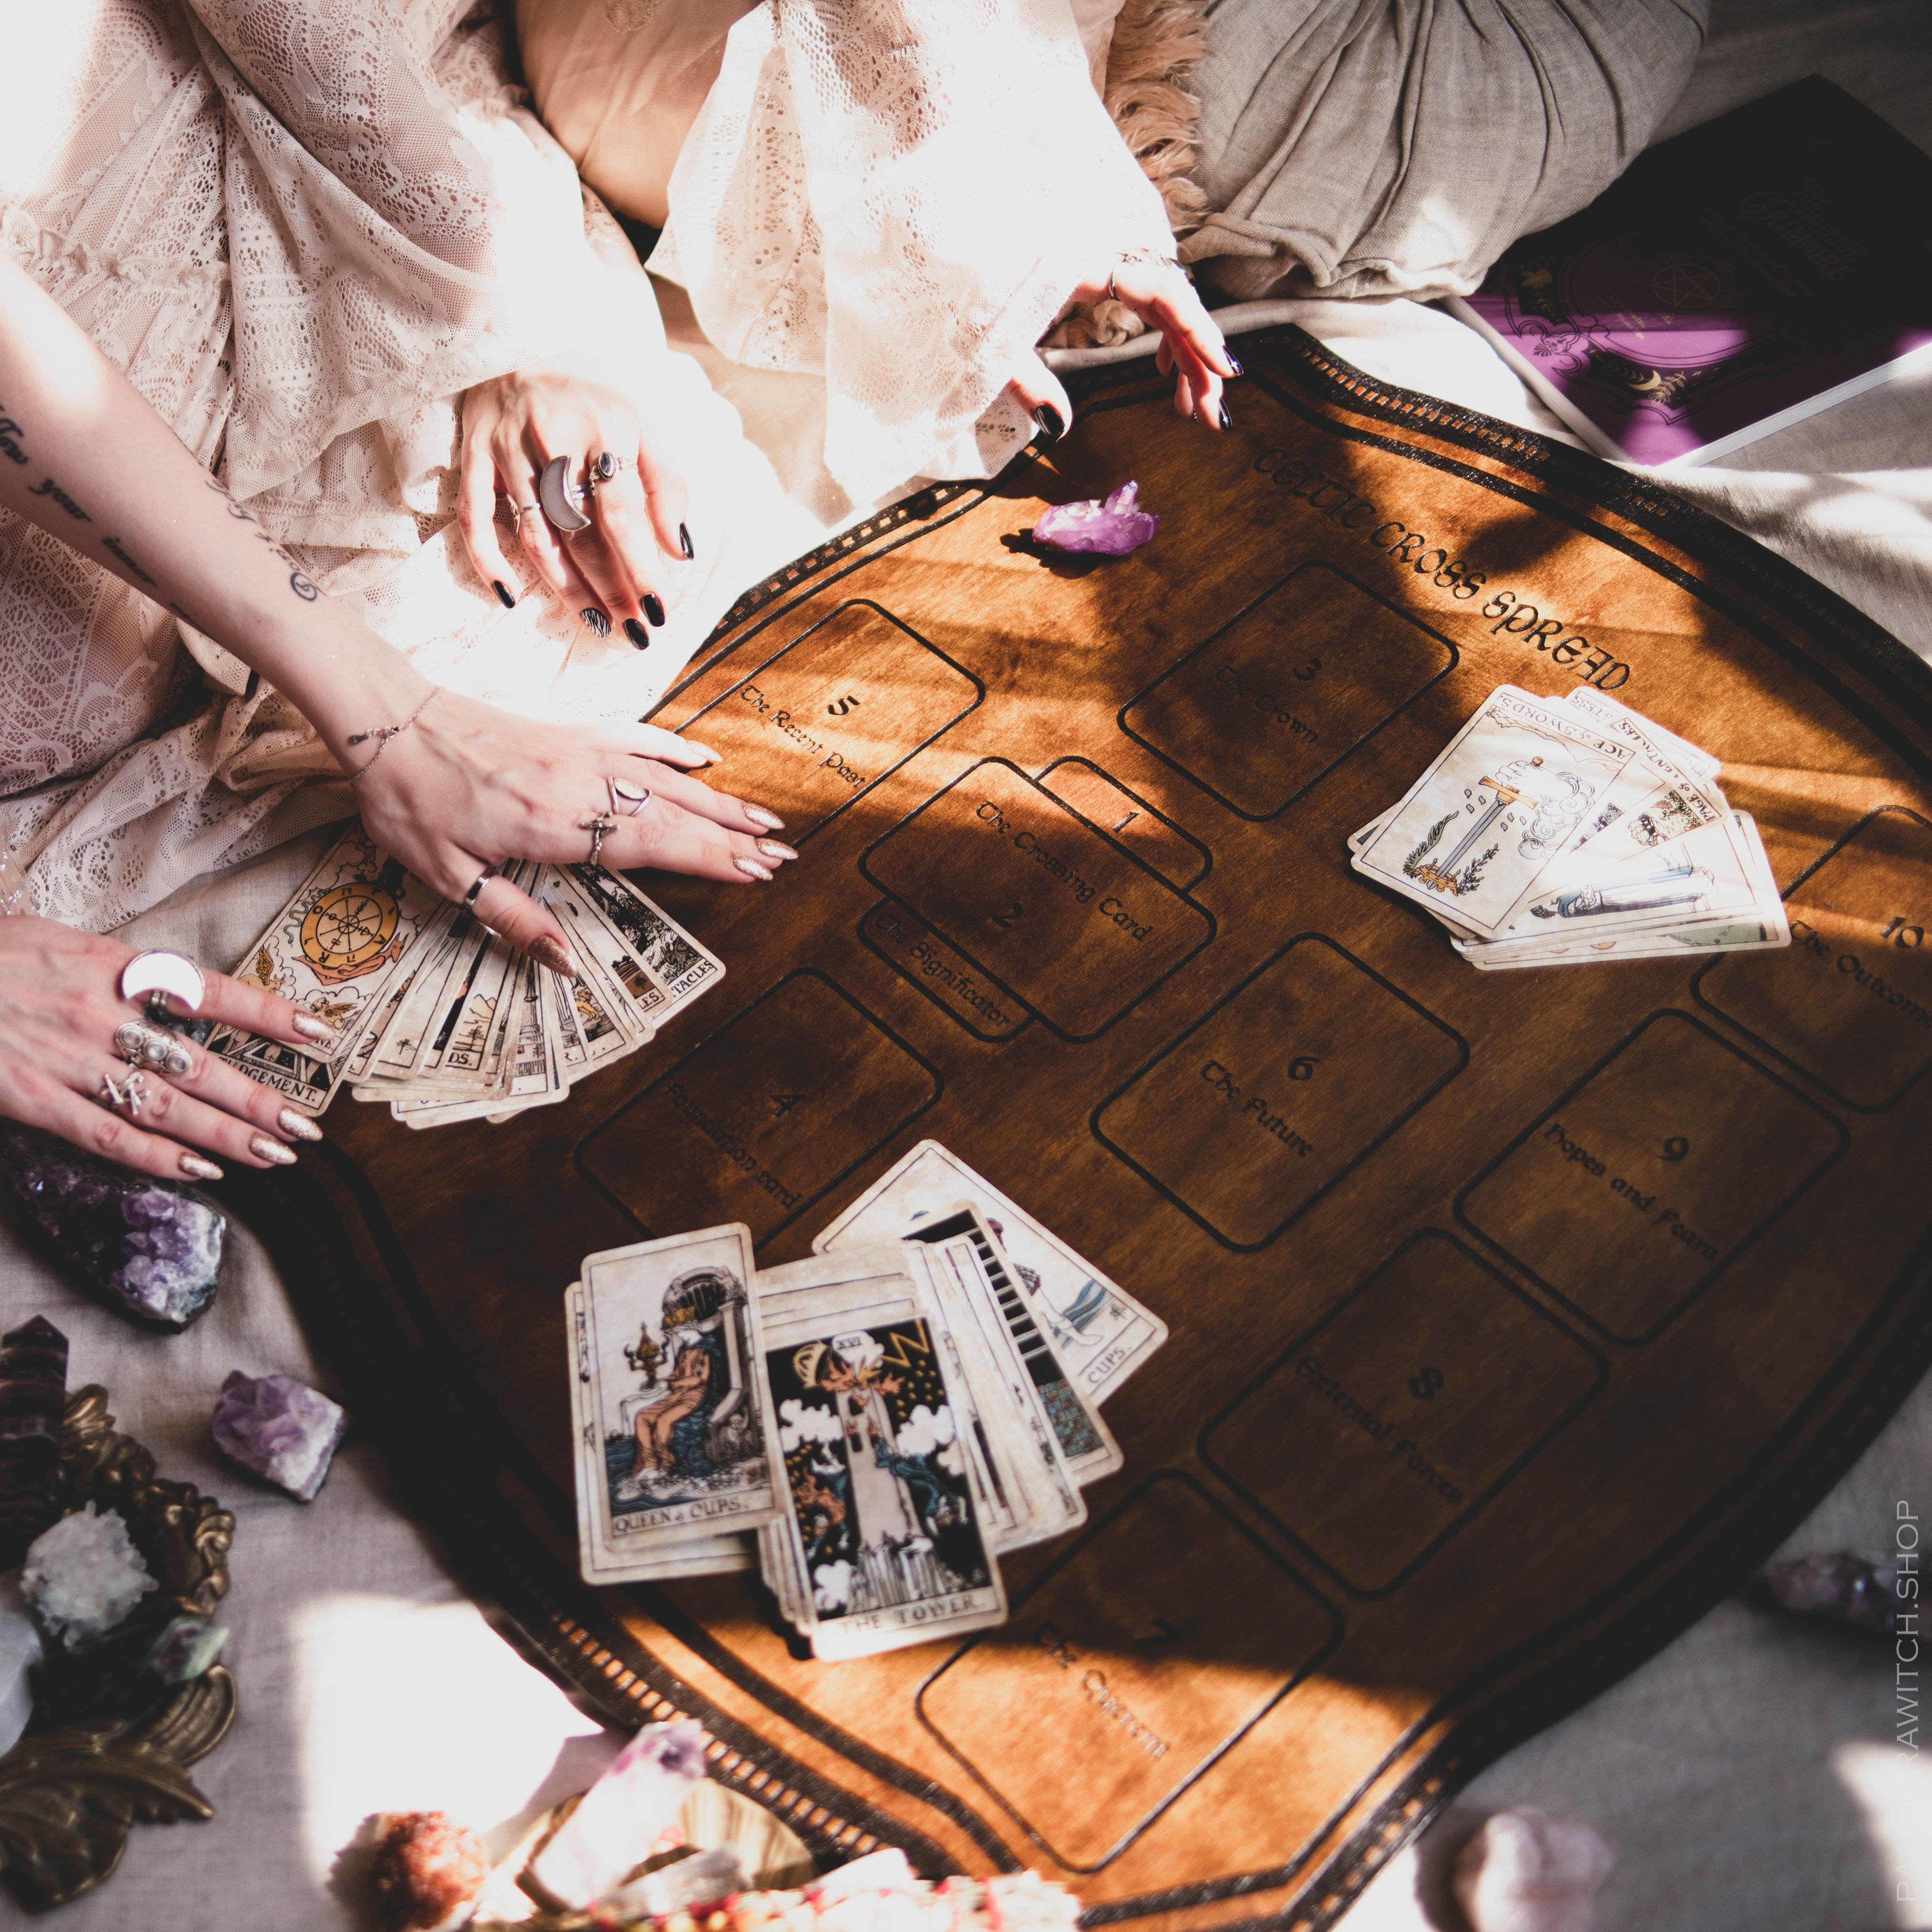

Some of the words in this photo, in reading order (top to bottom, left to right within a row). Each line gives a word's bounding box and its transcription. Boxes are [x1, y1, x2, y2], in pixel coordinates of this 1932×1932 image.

[1253, 448, 1376, 528] CELTIC
[1370, 522, 1486, 599] CROSS
[1482, 591, 1630, 690] SPREAD
[1293, 658, 1322, 681] 3
[827, 695, 861, 715] 5
[1215, 665, 1251, 696] The
[1254, 694, 1319, 744] Crown
[1500, 695, 1578, 735] SWORDS.
[740, 685, 770, 713] The
[769, 710, 823, 754] Recent
[818, 752, 866, 788] Past
[1593, 738, 1632, 760] ACE
[1112, 811, 1139, 833] 1
[1686, 793, 1716, 823] PAGE
[976, 801, 1011, 834] The
[1014, 831, 1096, 903] Crossing
[1099, 897, 1154, 941] Card
[990, 903, 1023, 928] 2
[1790, 920, 1830, 956] The
[1879, 917, 1924, 949] 10
[875, 911, 908, 944] The
[910, 941, 1010, 1026] Significator
[1287, 1056, 1321, 1080] 6
[770, 1094, 804, 1118] 4
[1201, 1059, 1240, 1099] The
[1237, 1097, 1313, 1157] Future
[1658, 1136, 1689, 1162] 9
[1543, 1122, 1607, 1177] Hopes
[1610, 1178, 1657, 1211] and
[1296, 1356, 1394, 1442] External
[1408, 1367, 1444, 1400] 8
[614, 1507, 672, 1533] QUEEN
